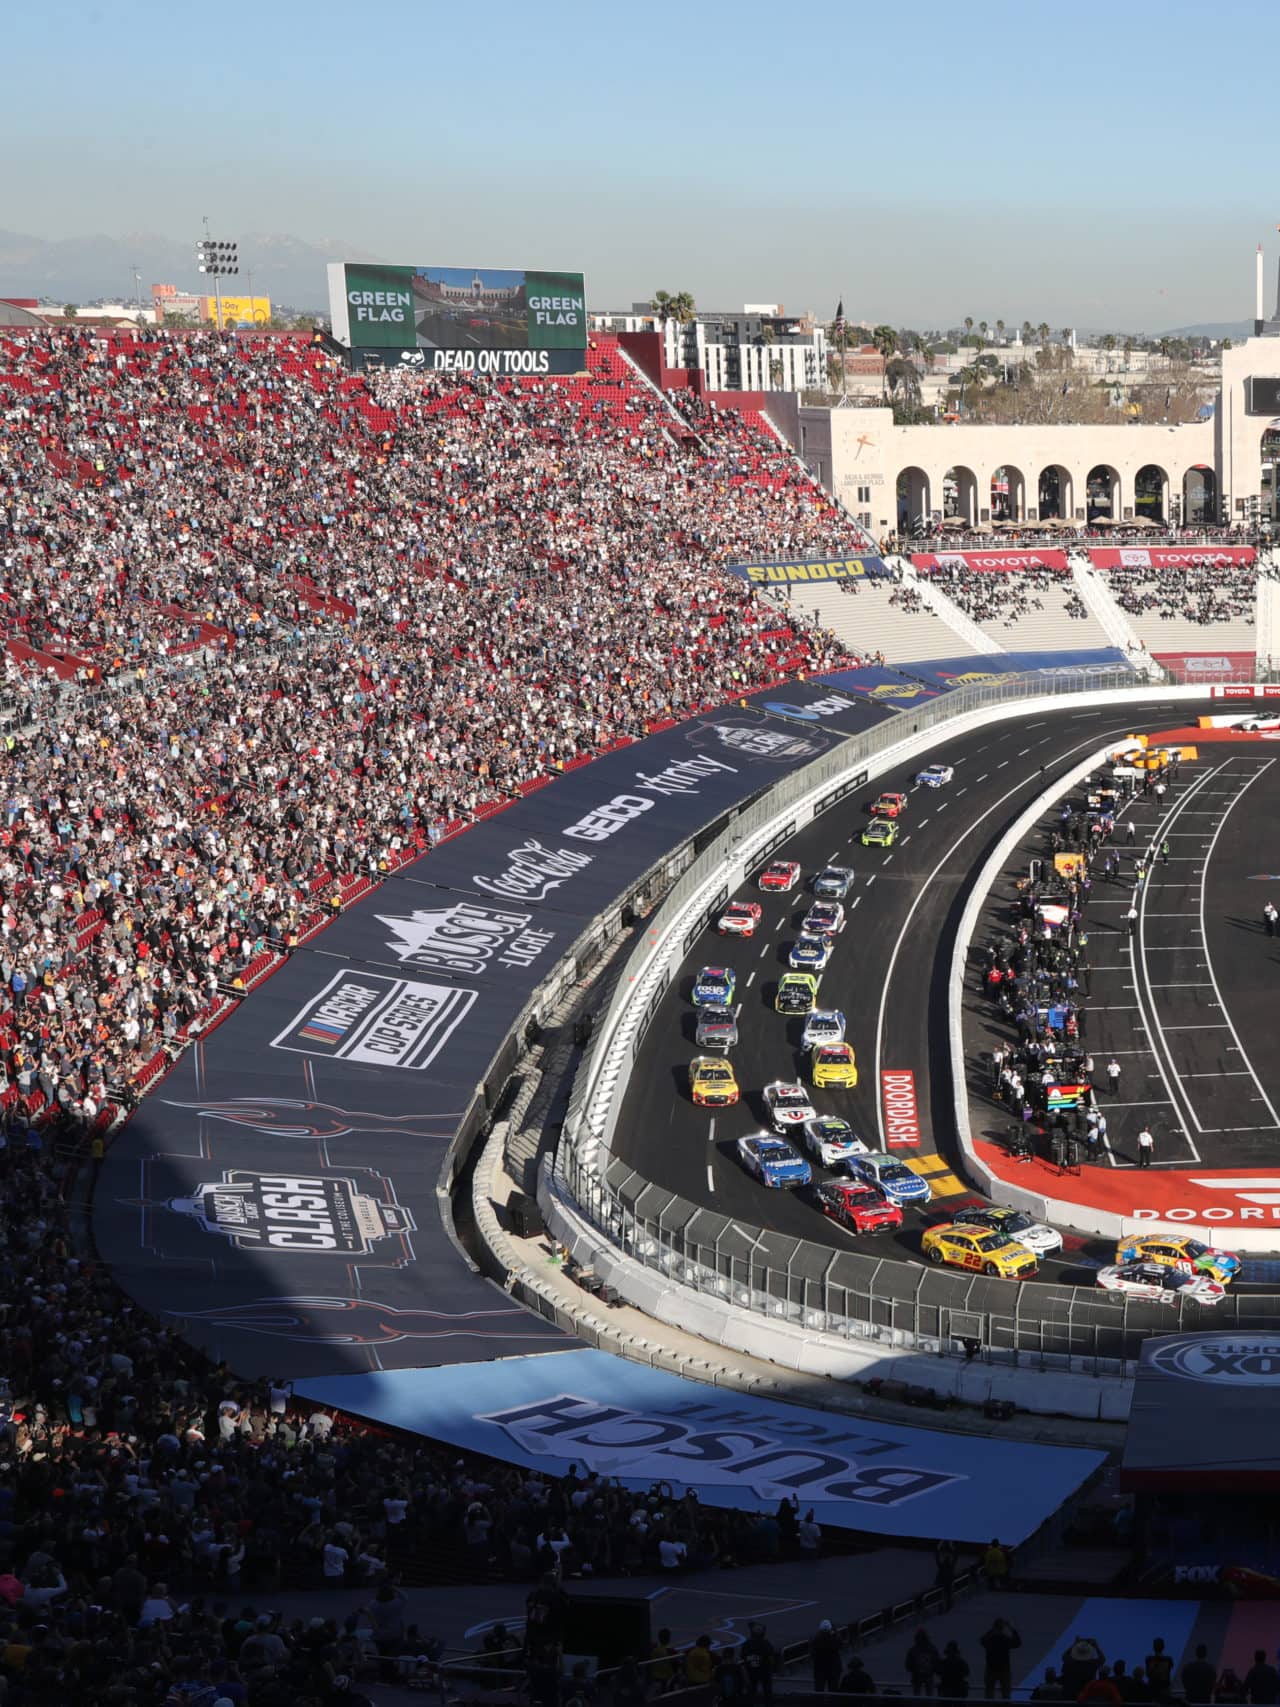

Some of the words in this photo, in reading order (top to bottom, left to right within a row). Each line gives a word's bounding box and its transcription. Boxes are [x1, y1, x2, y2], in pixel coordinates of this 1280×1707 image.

[349, 291, 410, 306] GREEN
[529, 296, 583, 310] GREEN
[357, 308, 404, 322] FLAG
[536, 311, 577, 326] FLAG
[434, 350, 476, 371] DEAD
[478, 350, 501, 372] ON
[503, 350, 549, 373] TOOLS
[971, 555, 1043, 567] TOYOTA
[1156, 552, 1227, 563] TOYOTA
[747, 559, 865, 582] SUNOCO
[869, 683, 924, 699] SUNOCO
[635, 754, 739, 796] xfinity
[562, 794, 655, 841] GEICO
[472, 838, 597, 900] Coca-Cola
[399, 902, 533, 975] BUSCH
[311, 983, 380, 1029] NASCAR
[364, 1013, 409, 1055] CUP
[394, 993, 439, 1033] SERIES
[883, 1075, 918, 1143] DOORDASH
[213, 1193, 247, 1224] BUSCH
[259, 1177, 337, 1249] CLASH
[963, 1252, 982, 1267] 22
[1176, 1260, 1192, 1275] 18
[653, 1403, 908, 1456] LIGHT
[478, 1397, 963, 1504] BUSCH
[1174, 1565, 1223, 1584] FOX
